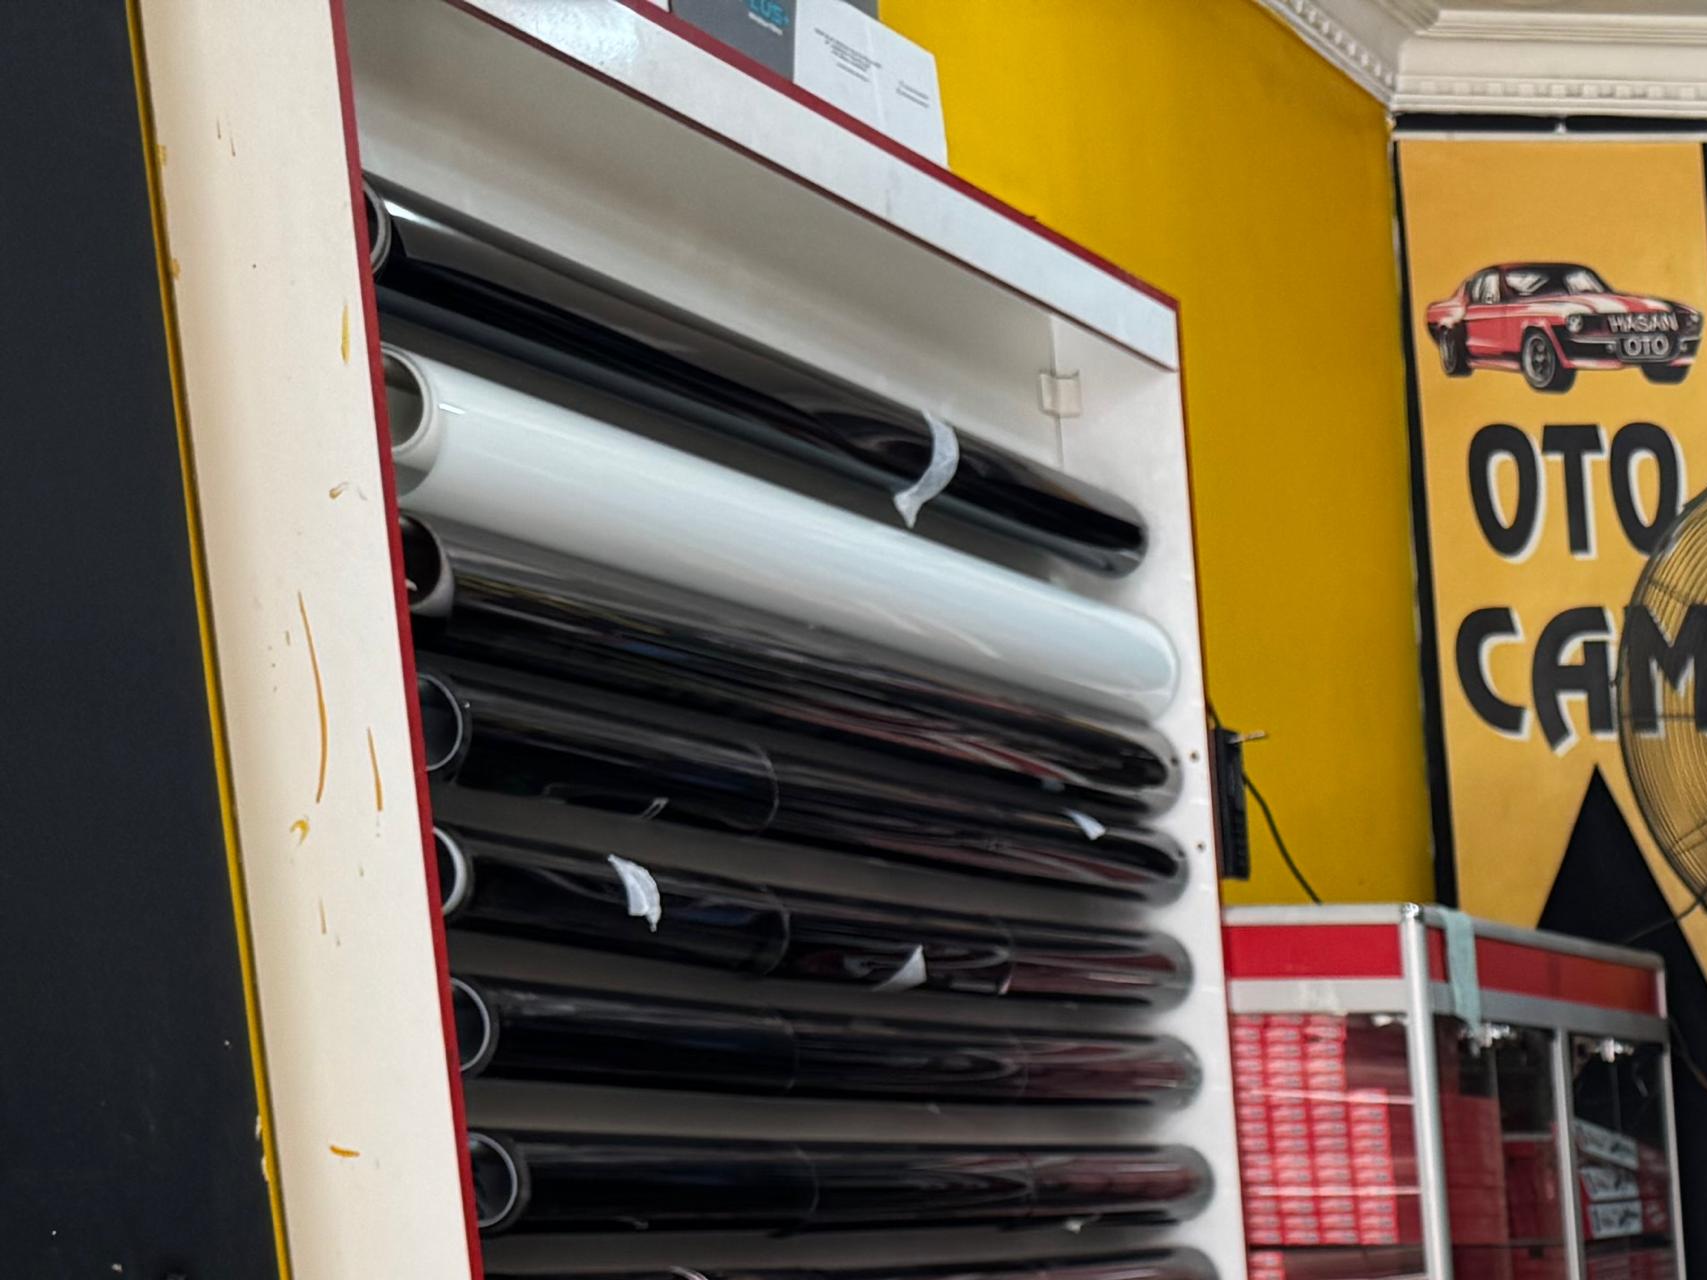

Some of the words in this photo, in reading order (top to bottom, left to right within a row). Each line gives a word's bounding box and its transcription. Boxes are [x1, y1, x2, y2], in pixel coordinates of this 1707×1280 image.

[1607, 312, 1678, 332] HASAN
[1623, 335, 1669, 356] OTO
[1468, 422, 1687, 563] OTO
